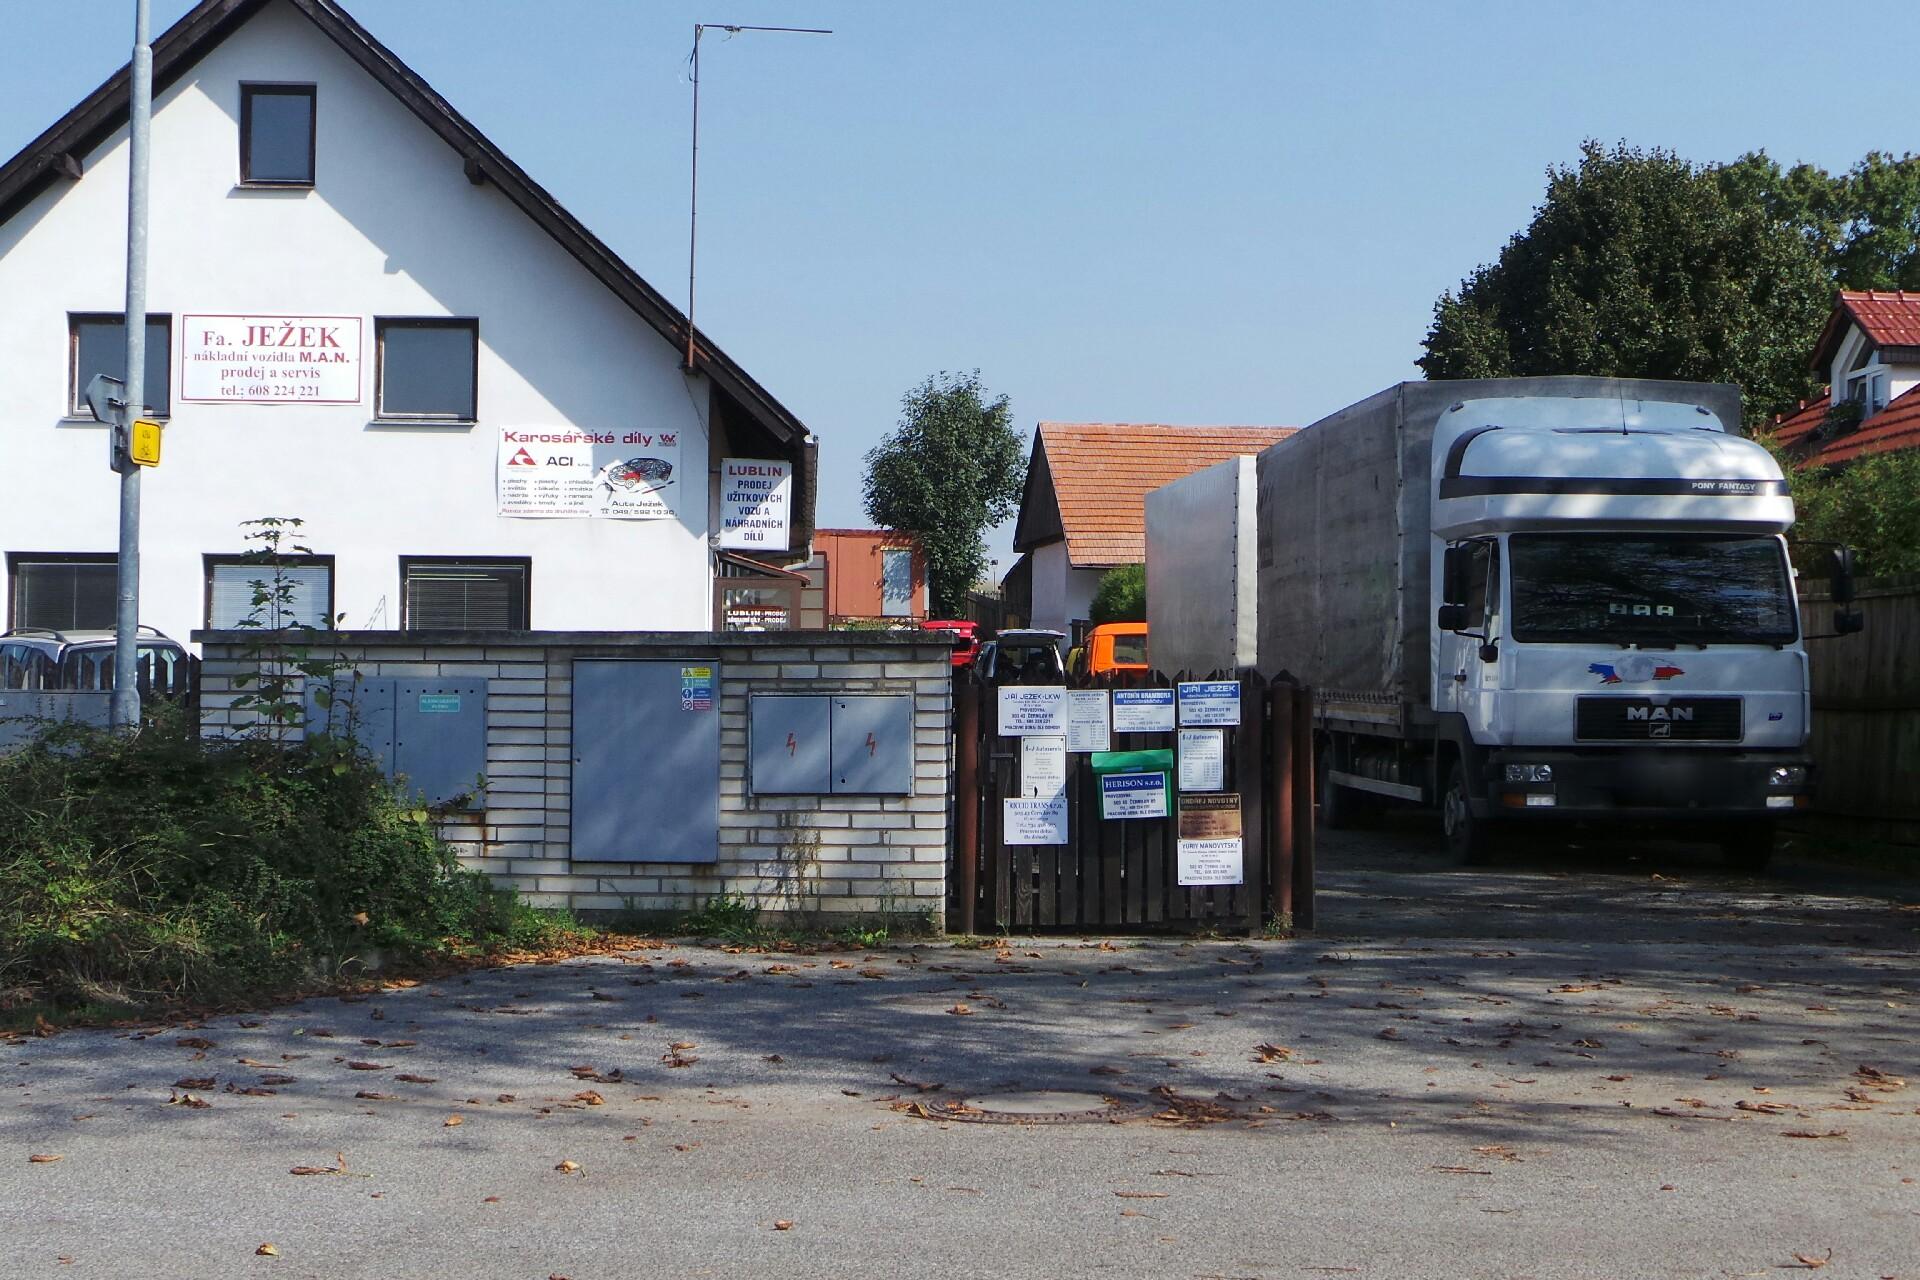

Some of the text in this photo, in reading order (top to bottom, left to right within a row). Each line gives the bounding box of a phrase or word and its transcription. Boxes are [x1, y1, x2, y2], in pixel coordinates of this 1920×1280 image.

[203, 320, 341, 348] Fa. JEŽEK
[194, 350, 350, 363] nákladní vozidla M.A.N.
[221, 367, 321, 380] prodej a servis
[221, 385, 319, 397] tel.: 608 224 221
[504, 431, 615, 444] Karosářské
[623, 431, 652, 447] díly
[546, 456, 573, 467] ACI
[729, 465, 782, 477] LUBLIN
[738, 480, 772, 490] PRODEJ
[1718, 482, 1755, 490] FANTASY
[727, 490, 782, 503] UŽITKOVÝCH
[765, 506, 770, 516] A
[725, 517, 783, 529] NÁHRADNÍCH
[1204, 684, 1236, 692] JEŽEK
[1627, 707, 1694, 721] MAN
[1105, 779, 1143, 788] HERISON
